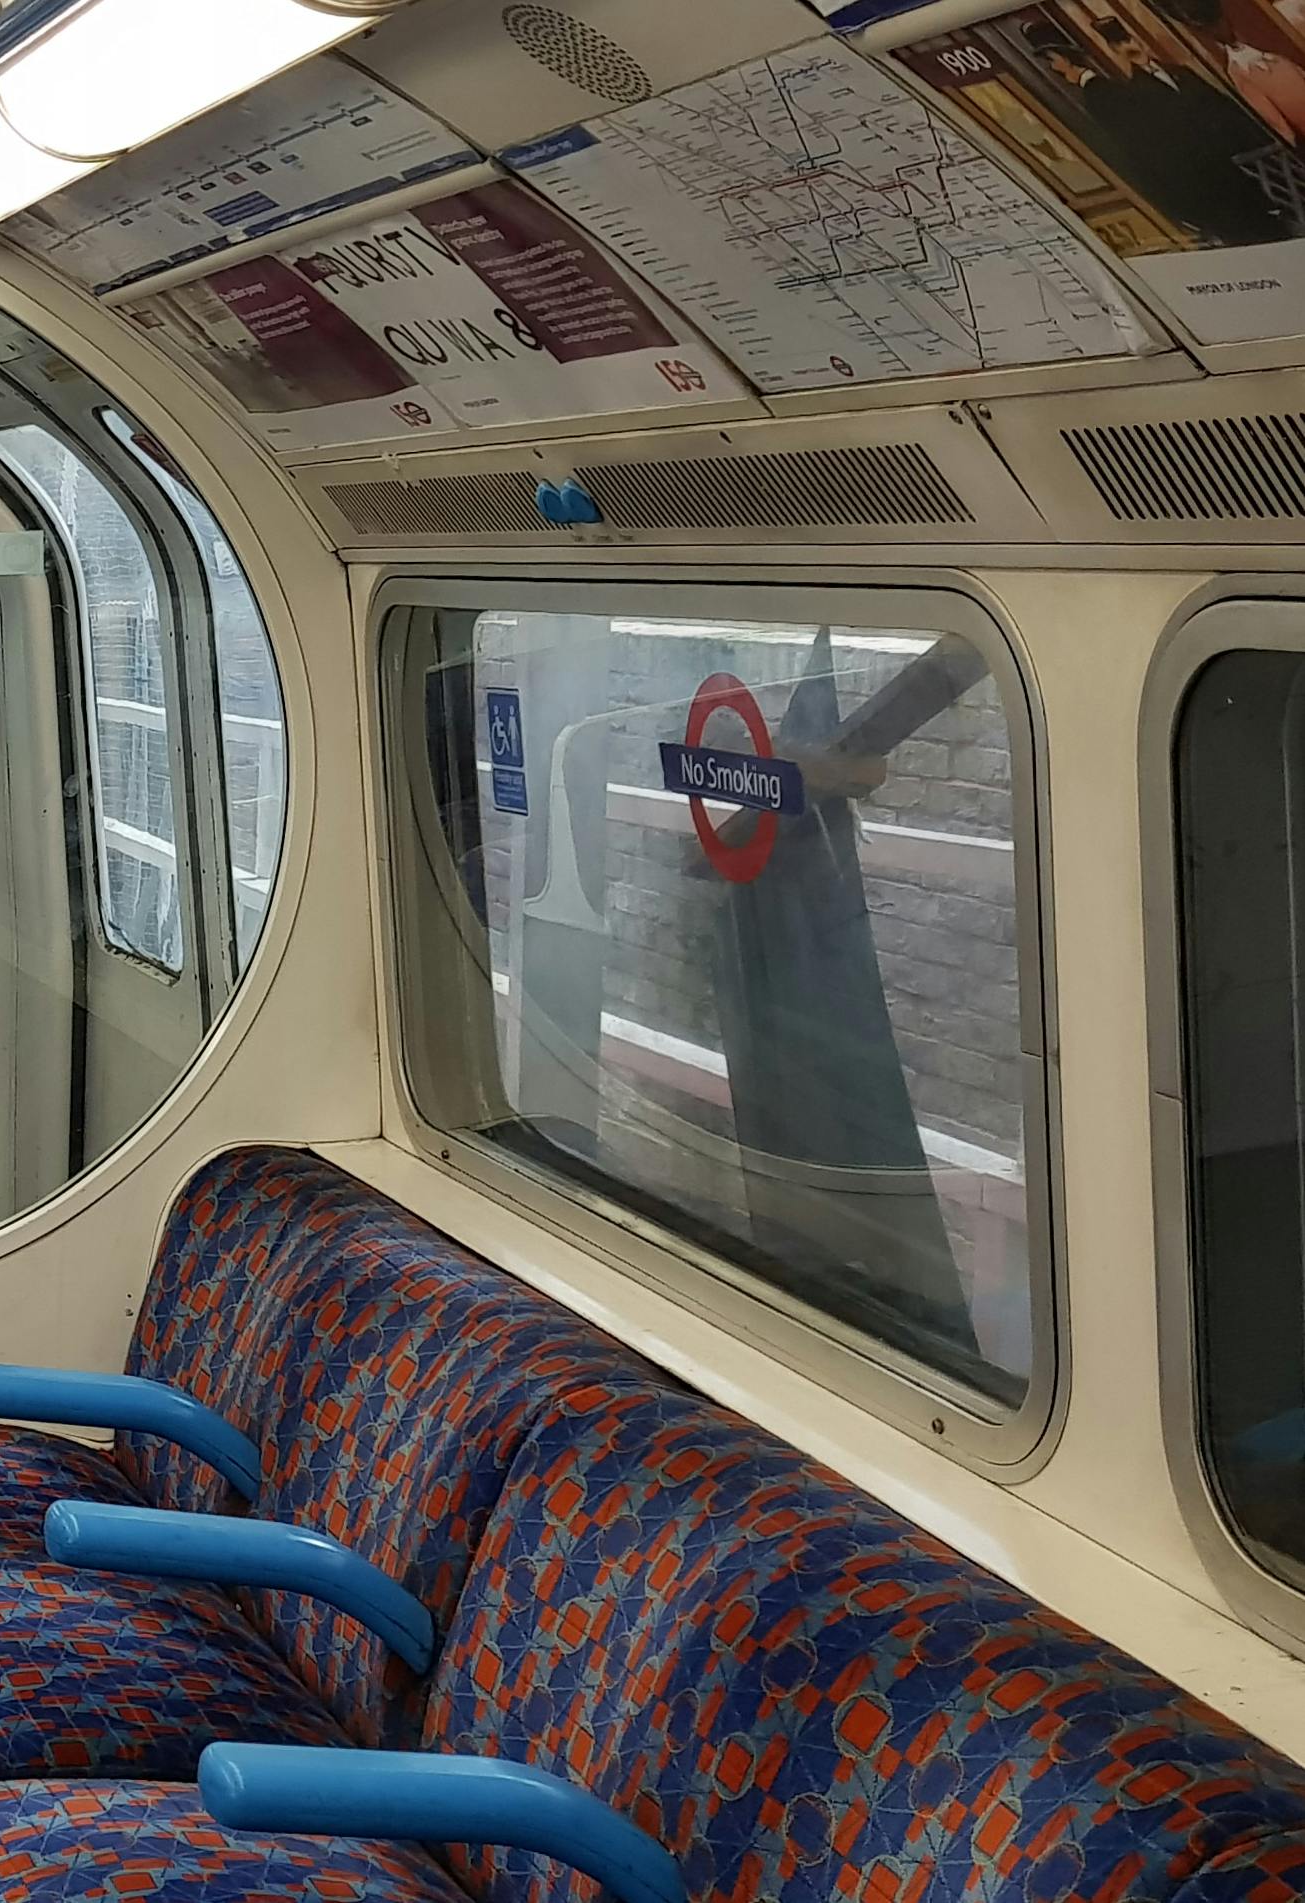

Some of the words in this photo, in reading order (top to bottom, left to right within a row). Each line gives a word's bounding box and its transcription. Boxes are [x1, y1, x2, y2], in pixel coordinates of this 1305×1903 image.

[936, 46, 992, 77] 1900
[655, 359, 706, 392] 150
[681, 753, 705, 786] No
[707, 756, 781, 808] Smoking
